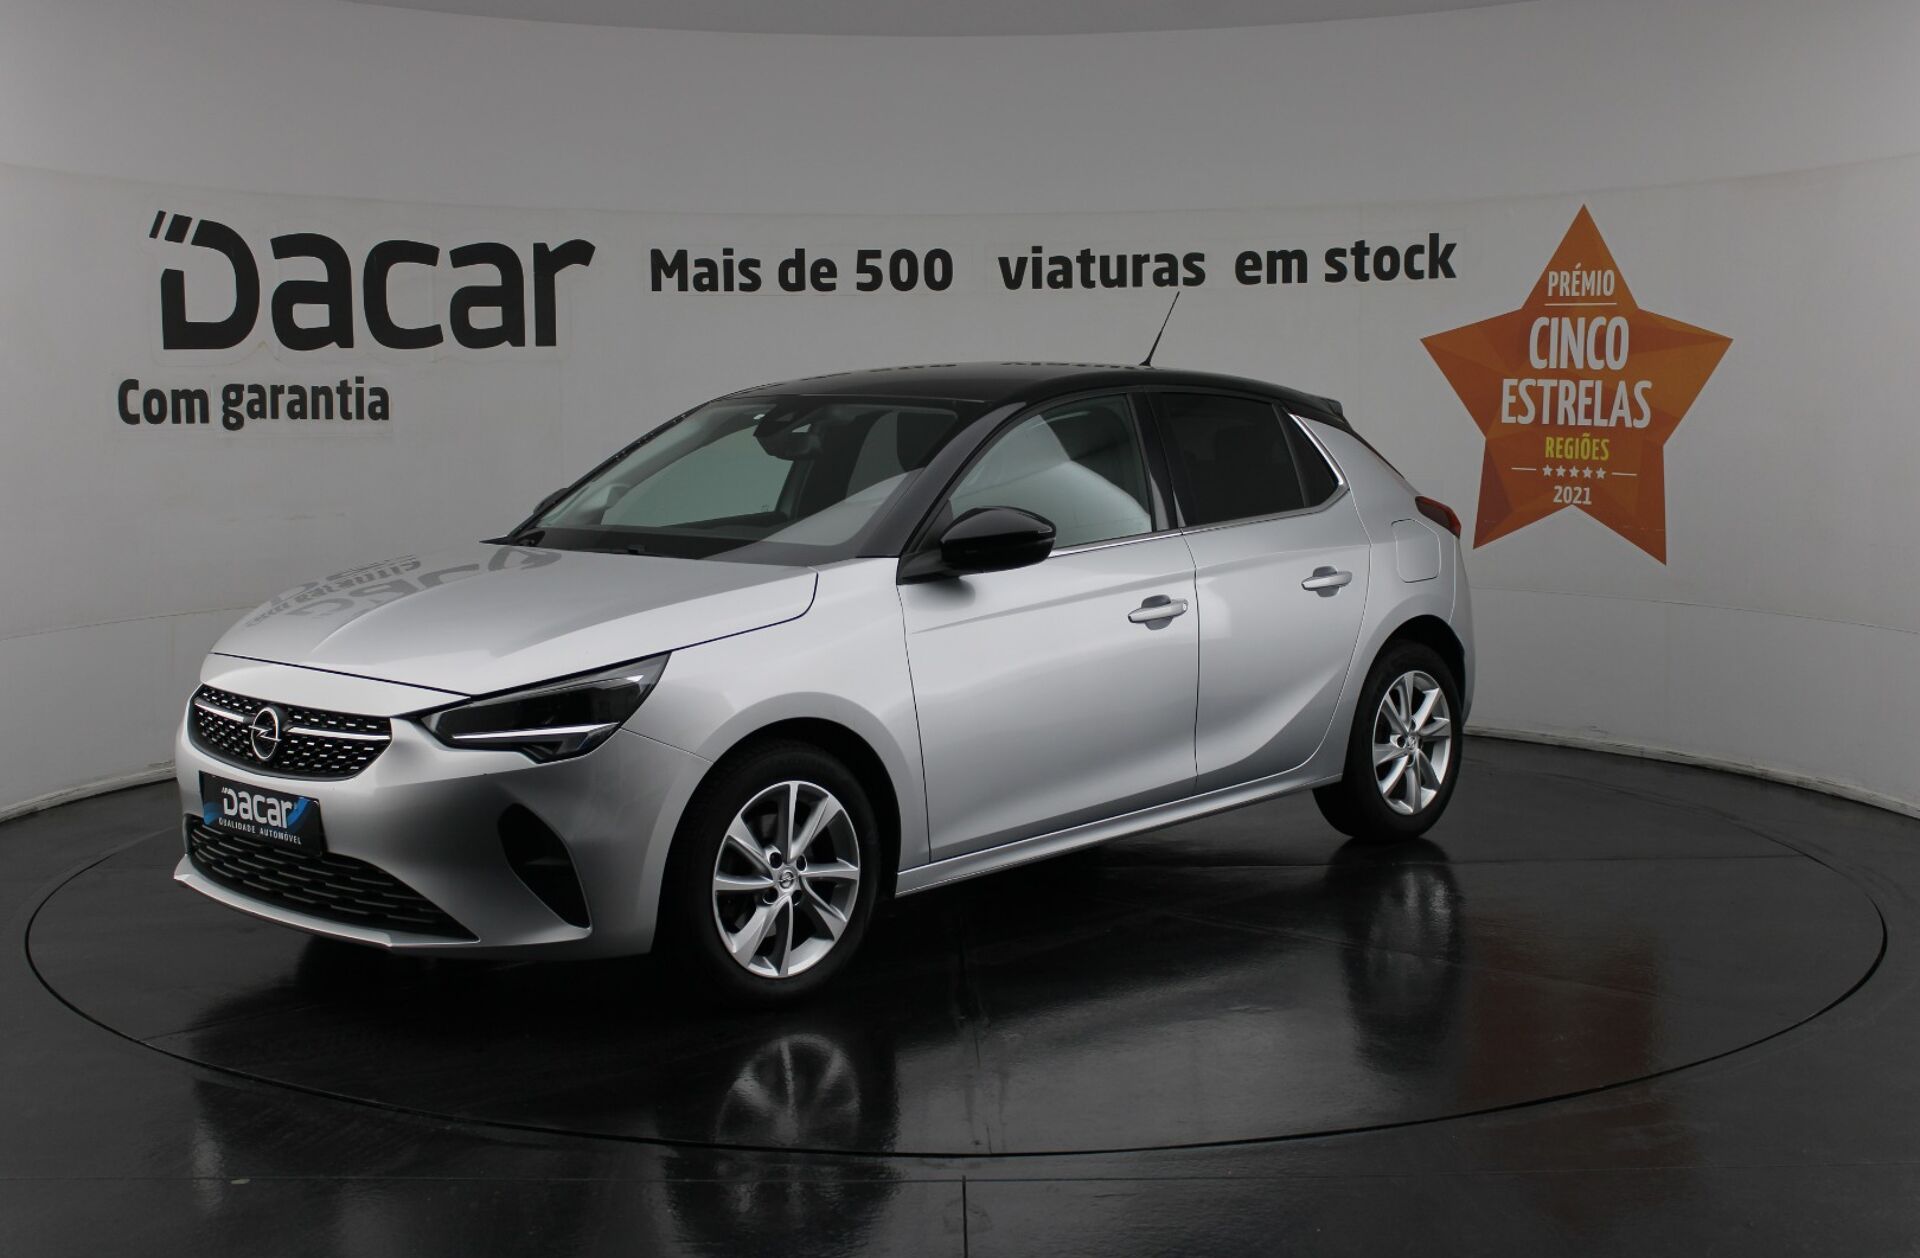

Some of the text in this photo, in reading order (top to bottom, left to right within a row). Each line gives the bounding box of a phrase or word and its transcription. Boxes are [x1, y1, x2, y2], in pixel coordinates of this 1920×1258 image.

[149, 211, 595, 351] Dacar
[651, 233, 1456, 292] Mais de 500 viaturas em stock
[1548, 263, 1615, 297] PRÉMIO
[1529, 316, 1630, 370] CINCO
[118, 376, 389, 431] Com garantia
[1501, 378, 1653, 428] ESTRELAS
[1545, 433, 1610, 461] REGIÕES
[1553, 485, 1592, 505] 2021
[221, 786, 292, 828] Dacar
[219, 817, 302, 845] QUALIDADE AUTOMÓVEL
